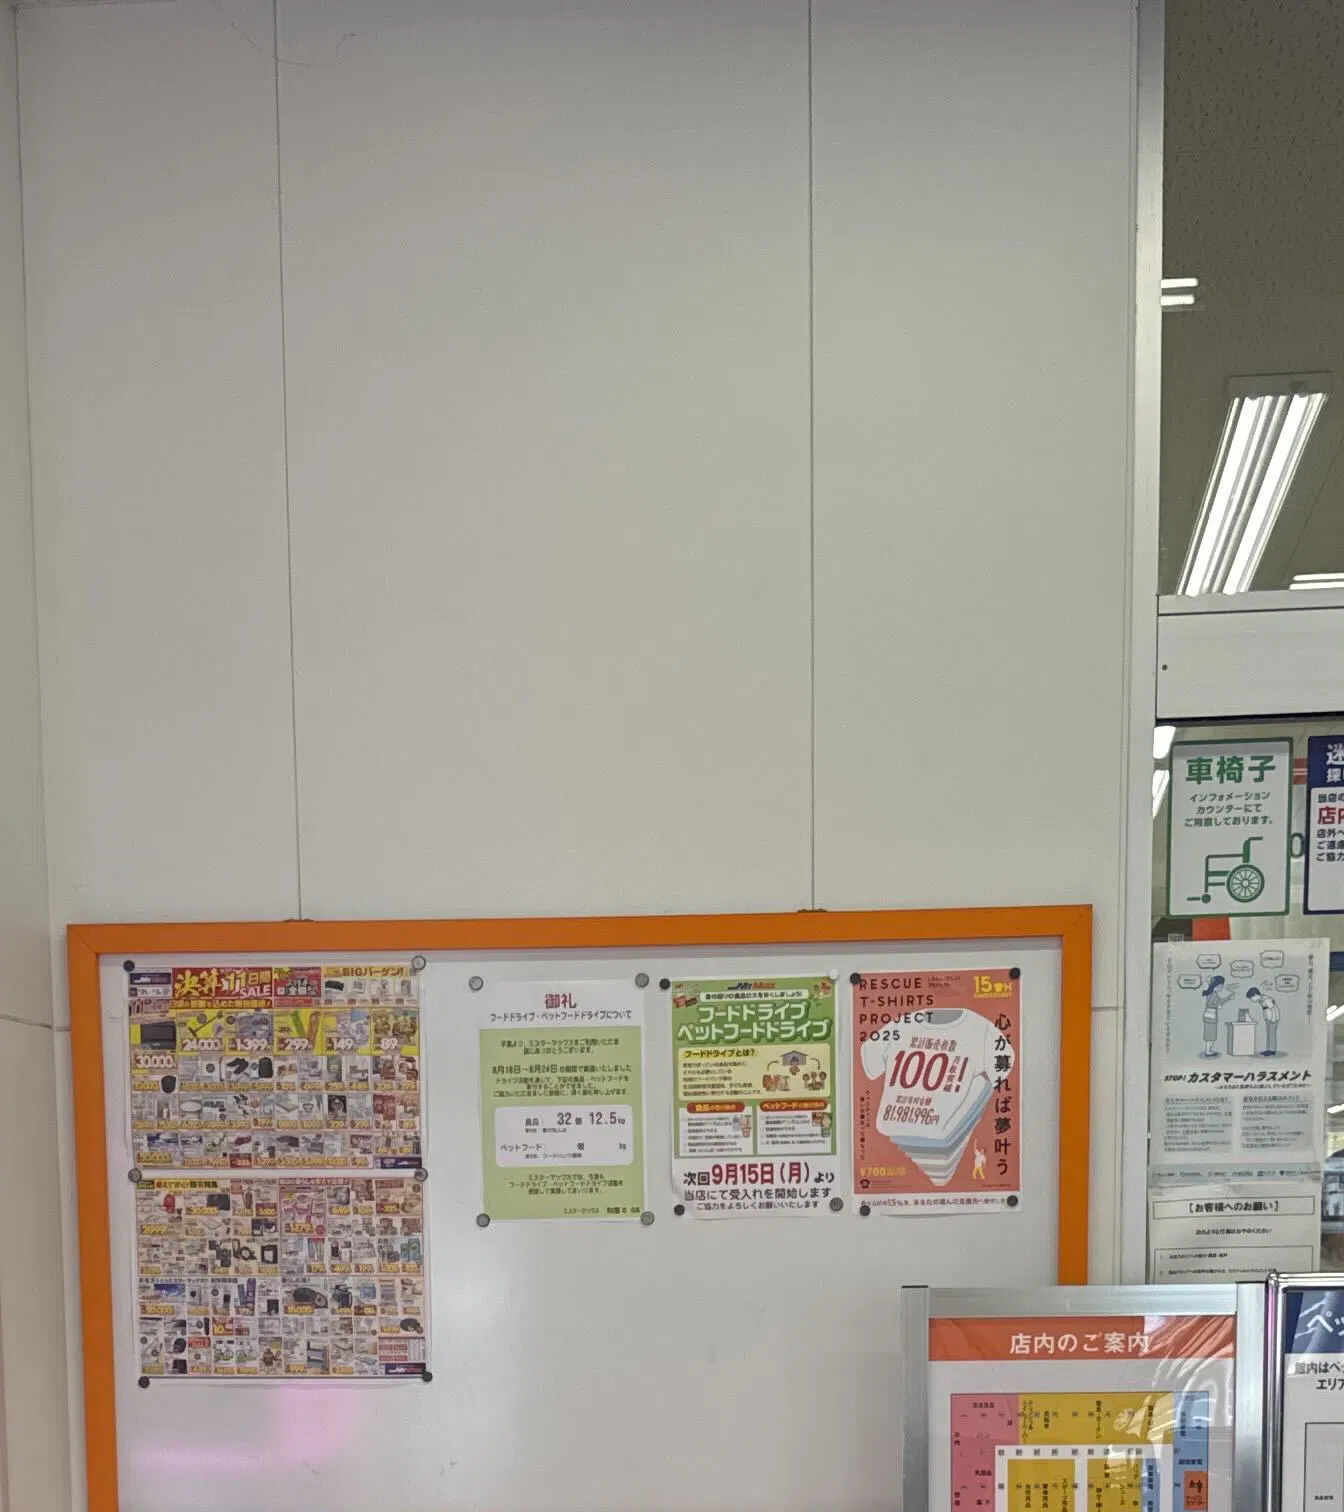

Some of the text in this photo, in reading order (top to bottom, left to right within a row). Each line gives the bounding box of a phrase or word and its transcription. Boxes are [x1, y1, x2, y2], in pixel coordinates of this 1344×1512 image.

[1185, 754, 1276, 785] 車椅子
[1189, 791, 1271, 803] インフォメーション
[1196, 804, 1262, 815] カウンターにて
[859, 977, 922, 990] RESCUE
[544, 992, 577, 1009] 御礼
[860, 995, 934, 1007] T-SHIRTS
[698, 1002, 807, 1023] フードドライブ
[860, 1012, 934, 1025] PROJECT
[677, 1021, 831, 1041] ペットフードドライブ
[860, 1030, 901, 1042] 2025
[1187, 1070, 1312, 1083] カスタマーハラスメント
[557, 1112, 572, 1126] 32
[1009, 1331, 1150, 1355] 店内のご案内
